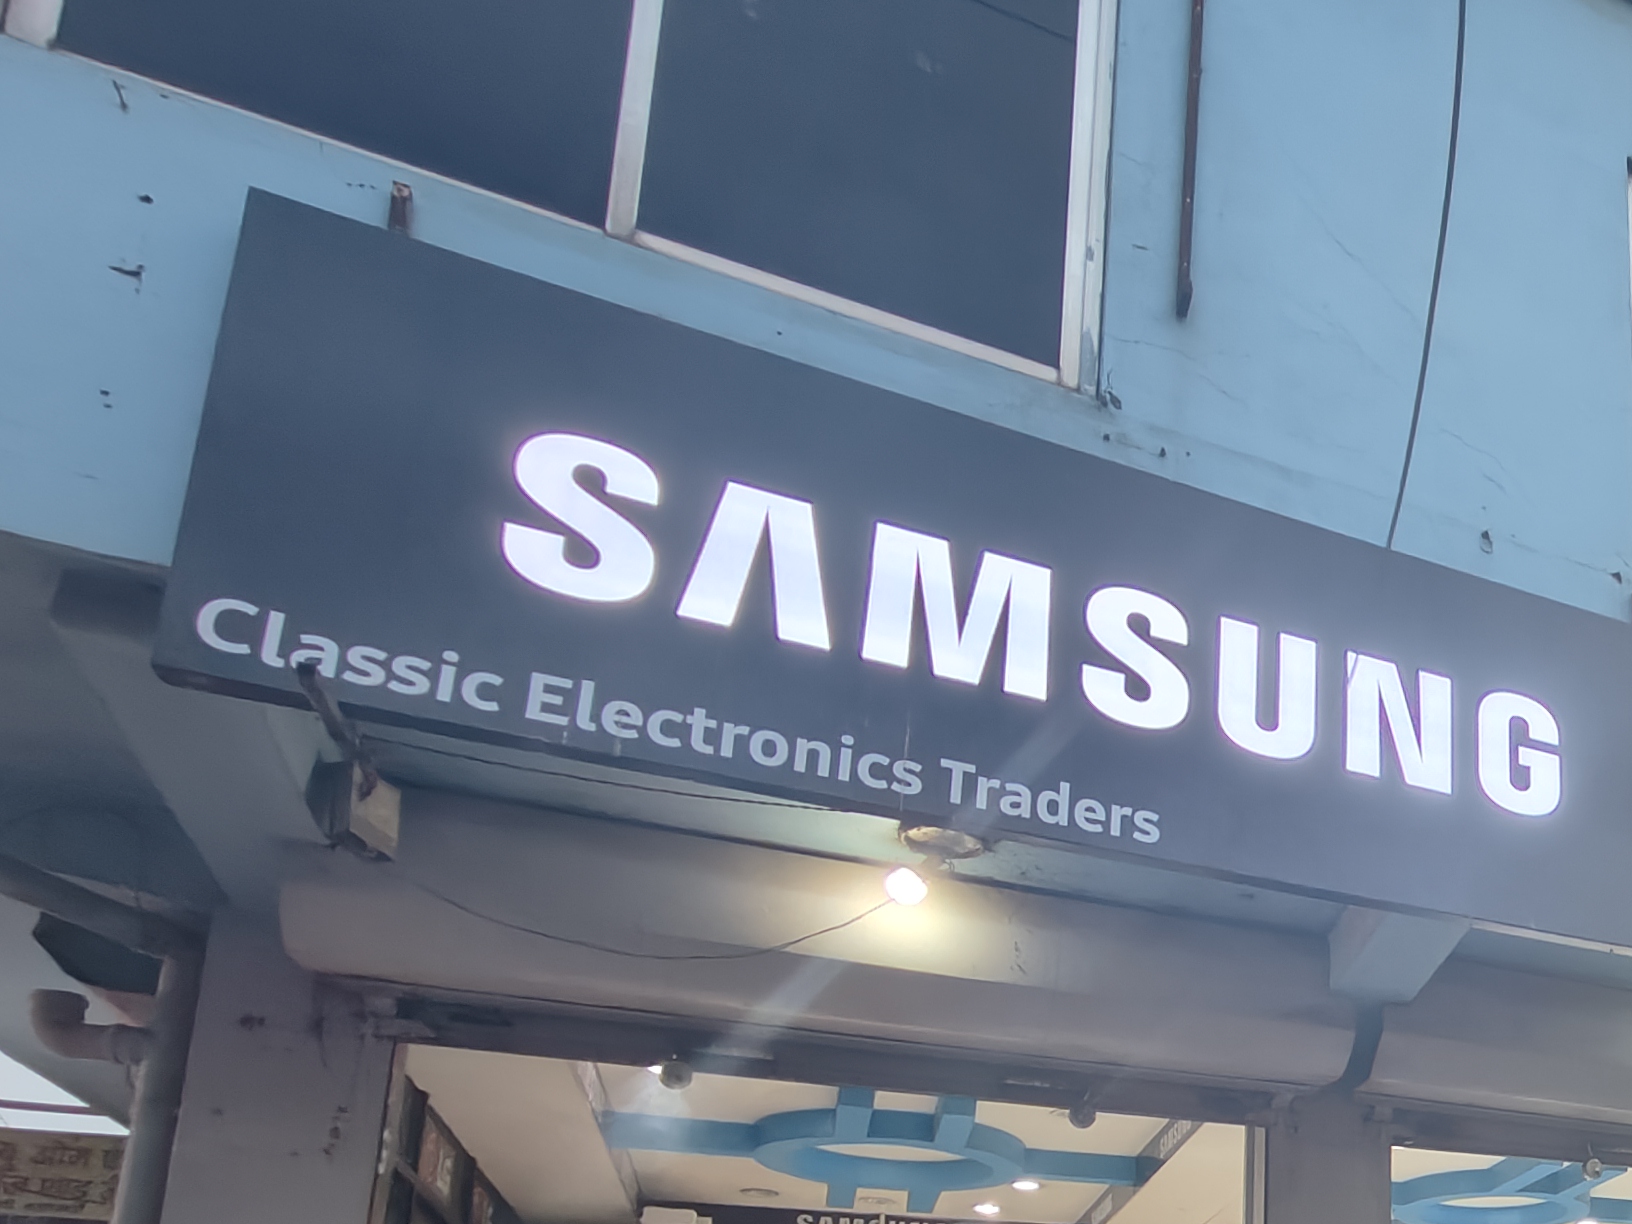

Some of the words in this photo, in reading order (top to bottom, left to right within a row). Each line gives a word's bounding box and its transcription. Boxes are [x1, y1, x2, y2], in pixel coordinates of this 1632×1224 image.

[195, 598, 502, 713] Classic
[524, 671, 924, 795] Electronics
[939, 757, 1162, 844] Traders
[501, 431, 1562, 817] SAMSUNG
